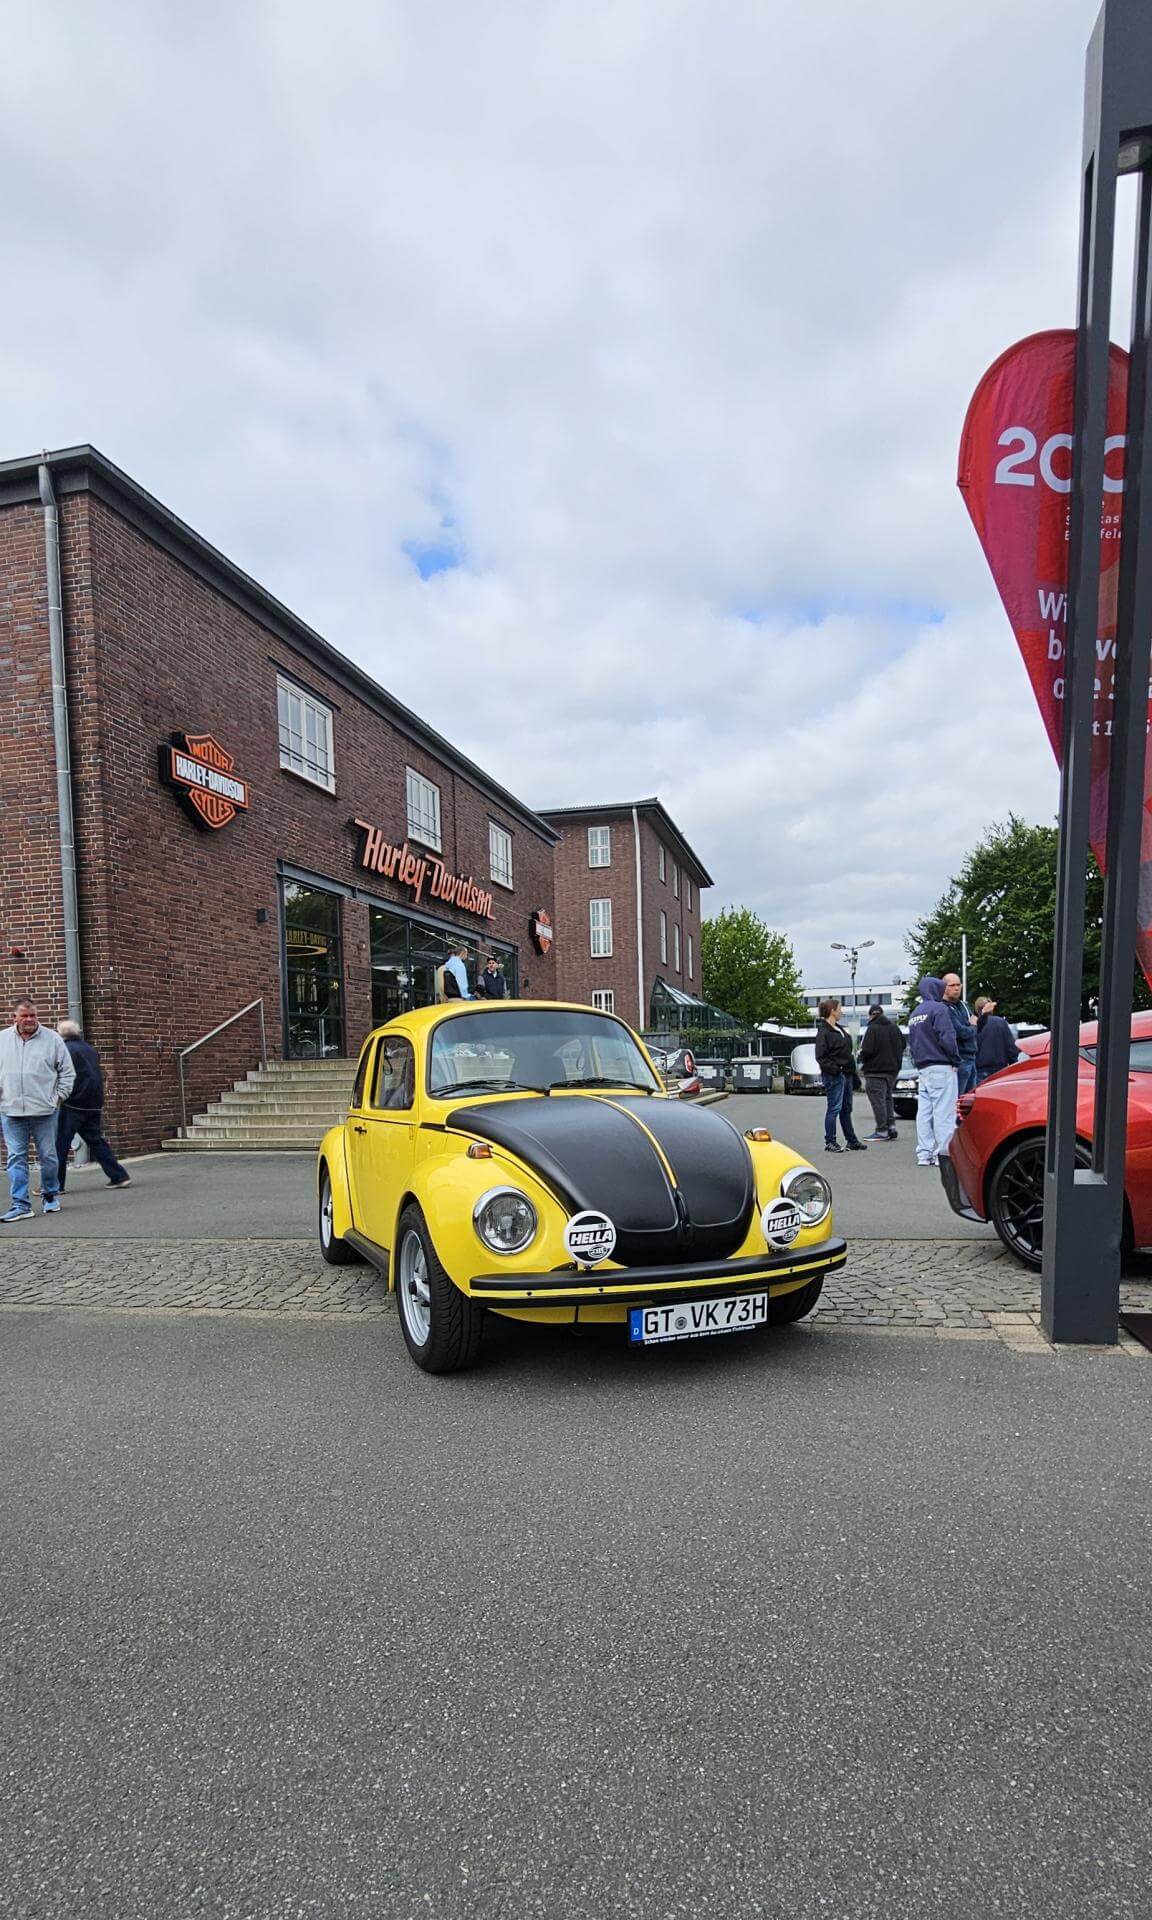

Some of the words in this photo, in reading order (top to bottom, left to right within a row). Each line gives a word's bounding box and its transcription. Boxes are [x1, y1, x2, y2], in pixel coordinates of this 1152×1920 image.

[191, 741, 230, 772] MOTOR
[176, 754, 245, 804] HARLEY-DAVIDSON
[194, 789, 232, 822] CYCLES
[354, 818, 497, 921] Harley-Davidson
[570, 1229, 612, 1245] HELLA
[768, 1213, 800, 1232] HELLA
[633, 1327, 639, 1335] D
[645, 1309, 675, 1335] GT
[691, 1303, 719, 1329] VK
[724, 1296, 766, 1324] 73H
